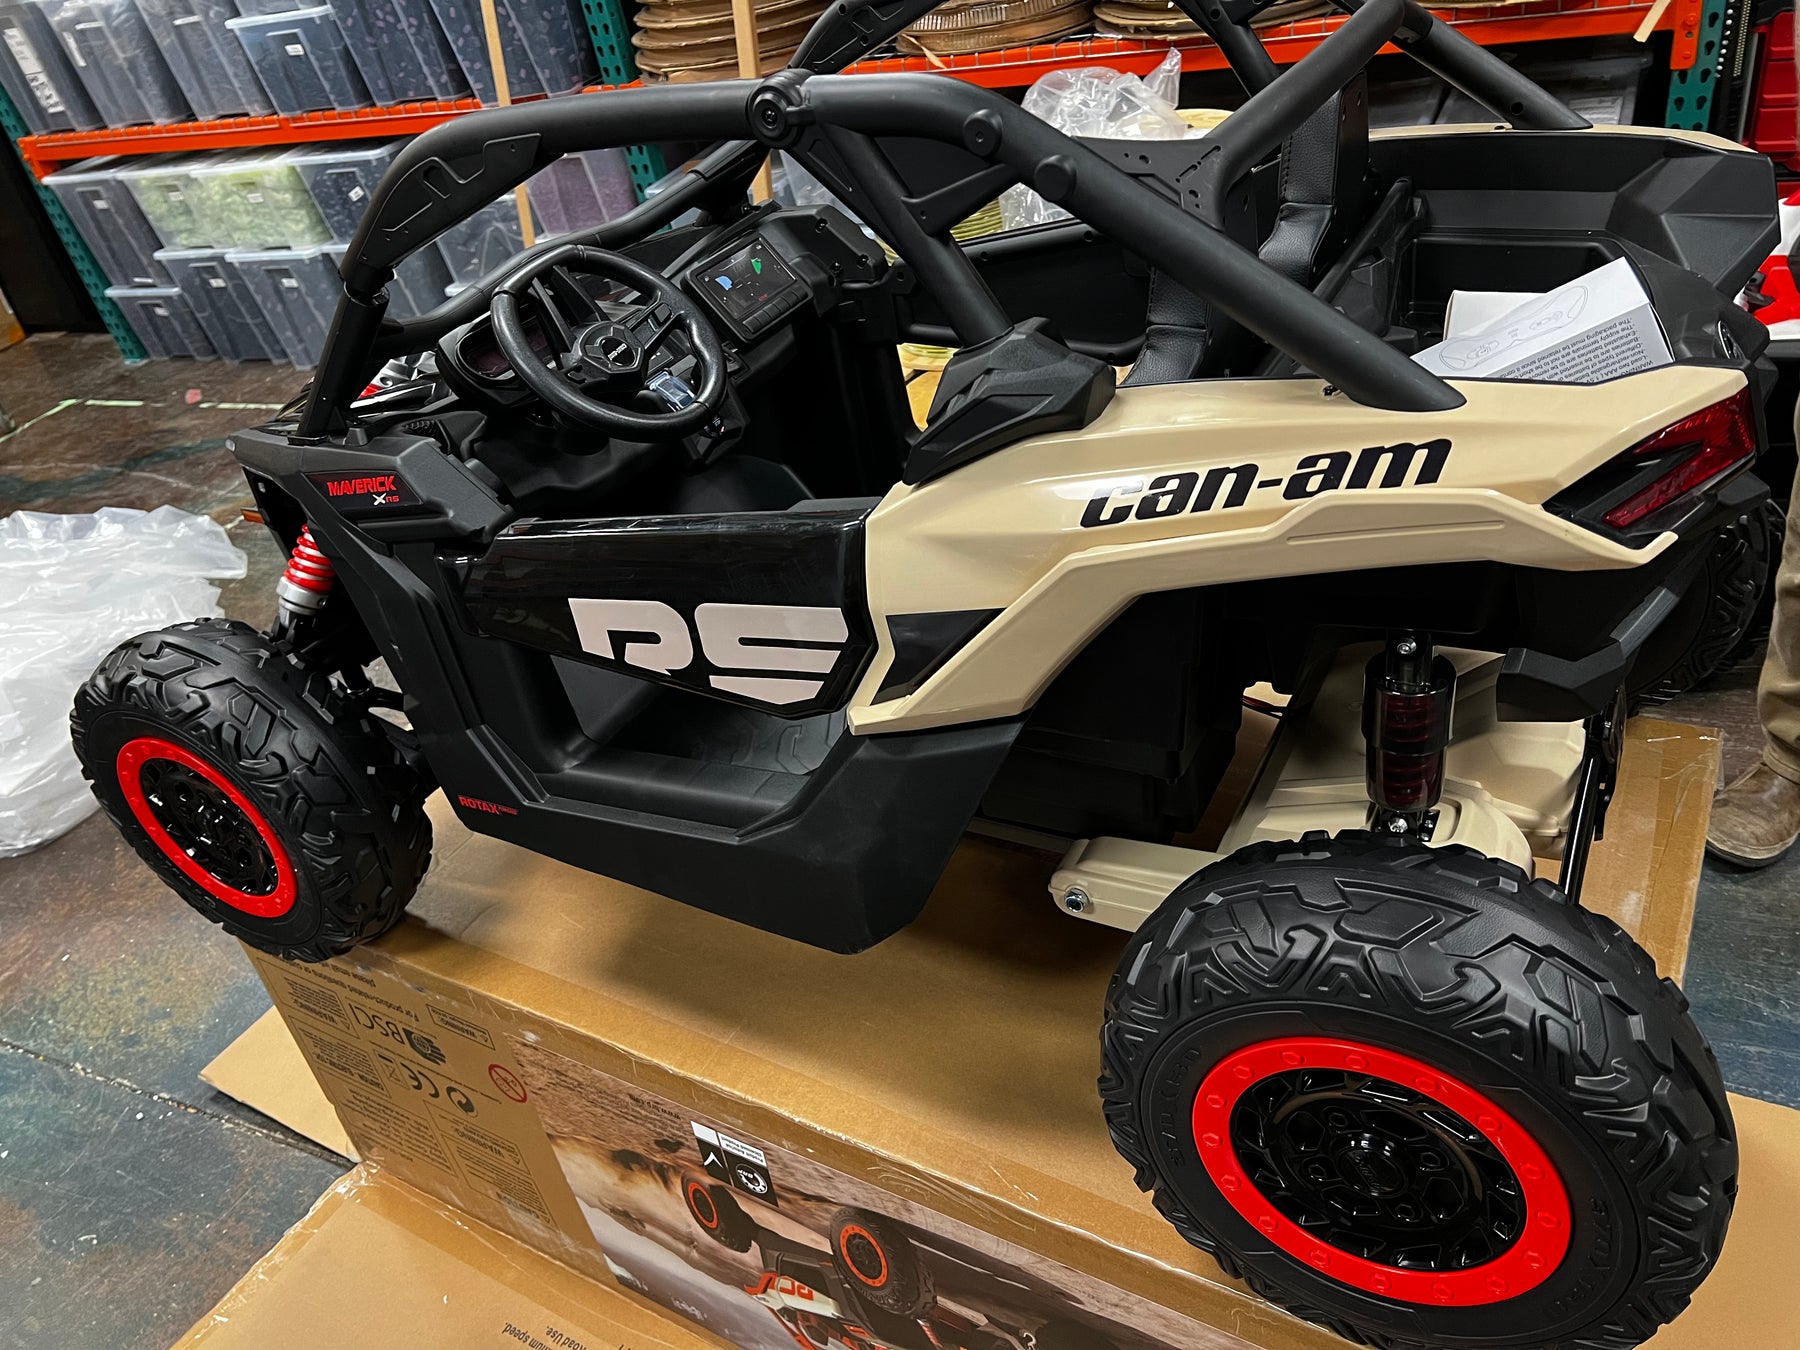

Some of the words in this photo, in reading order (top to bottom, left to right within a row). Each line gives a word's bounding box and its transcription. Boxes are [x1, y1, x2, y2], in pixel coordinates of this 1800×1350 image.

[1585, 324, 1617, 339] packaging
[1599, 329, 1619, 340] supply
[1570, 338, 1585, 347] must
[1571, 339, 1599, 353] terminals
[1536, 349, 1561, 361] retained
[1577, 345, 1603, 358] batteries
[1520, 360, 1536, 369] since
[1597, 354, 1614, 364] types
[1559, 361, 1583, 373] inserted
[1564, 365, 1590, 378] batteries
[326, 475, 397, 497] MAVERICK
[1080, 438, 1452, 529] can-am
[568, 597, 849, 705] RS
[458, 796, 501, 815] ROTAX
[348, 1003, 405, 1045] BSCI
[501, 1322, 531, 1344] speed.
[545, 1325, 564, 1345] Use.
